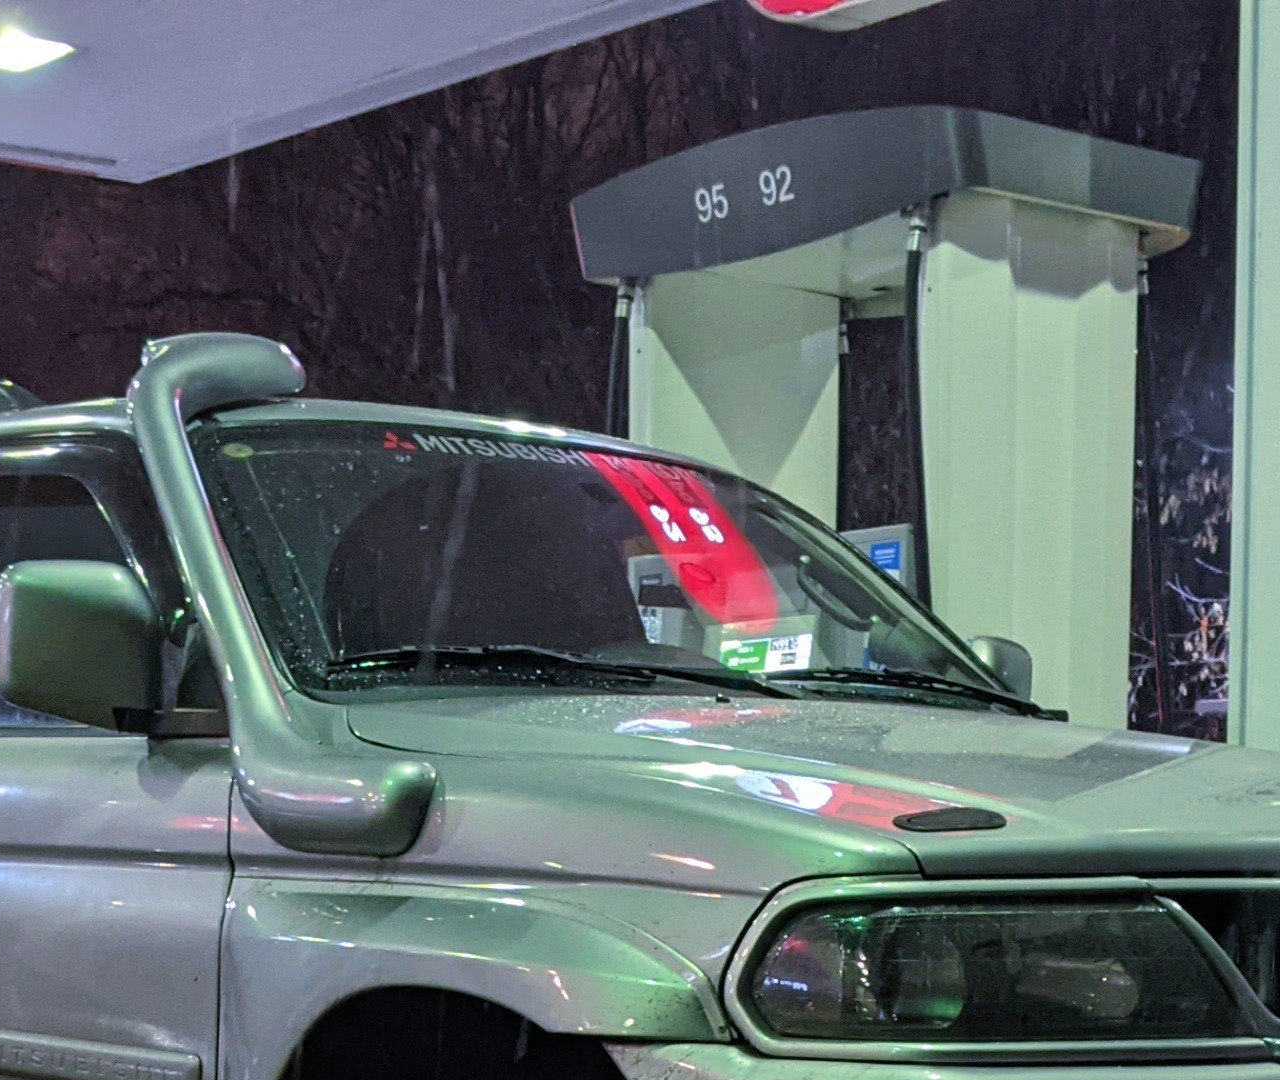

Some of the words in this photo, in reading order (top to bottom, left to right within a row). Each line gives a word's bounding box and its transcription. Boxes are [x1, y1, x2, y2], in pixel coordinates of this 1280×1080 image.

[694, 182, 730, 224] 95
[758, 164, 796, 207] 92
[412, 432, 598, 468] MITSUBISHI
